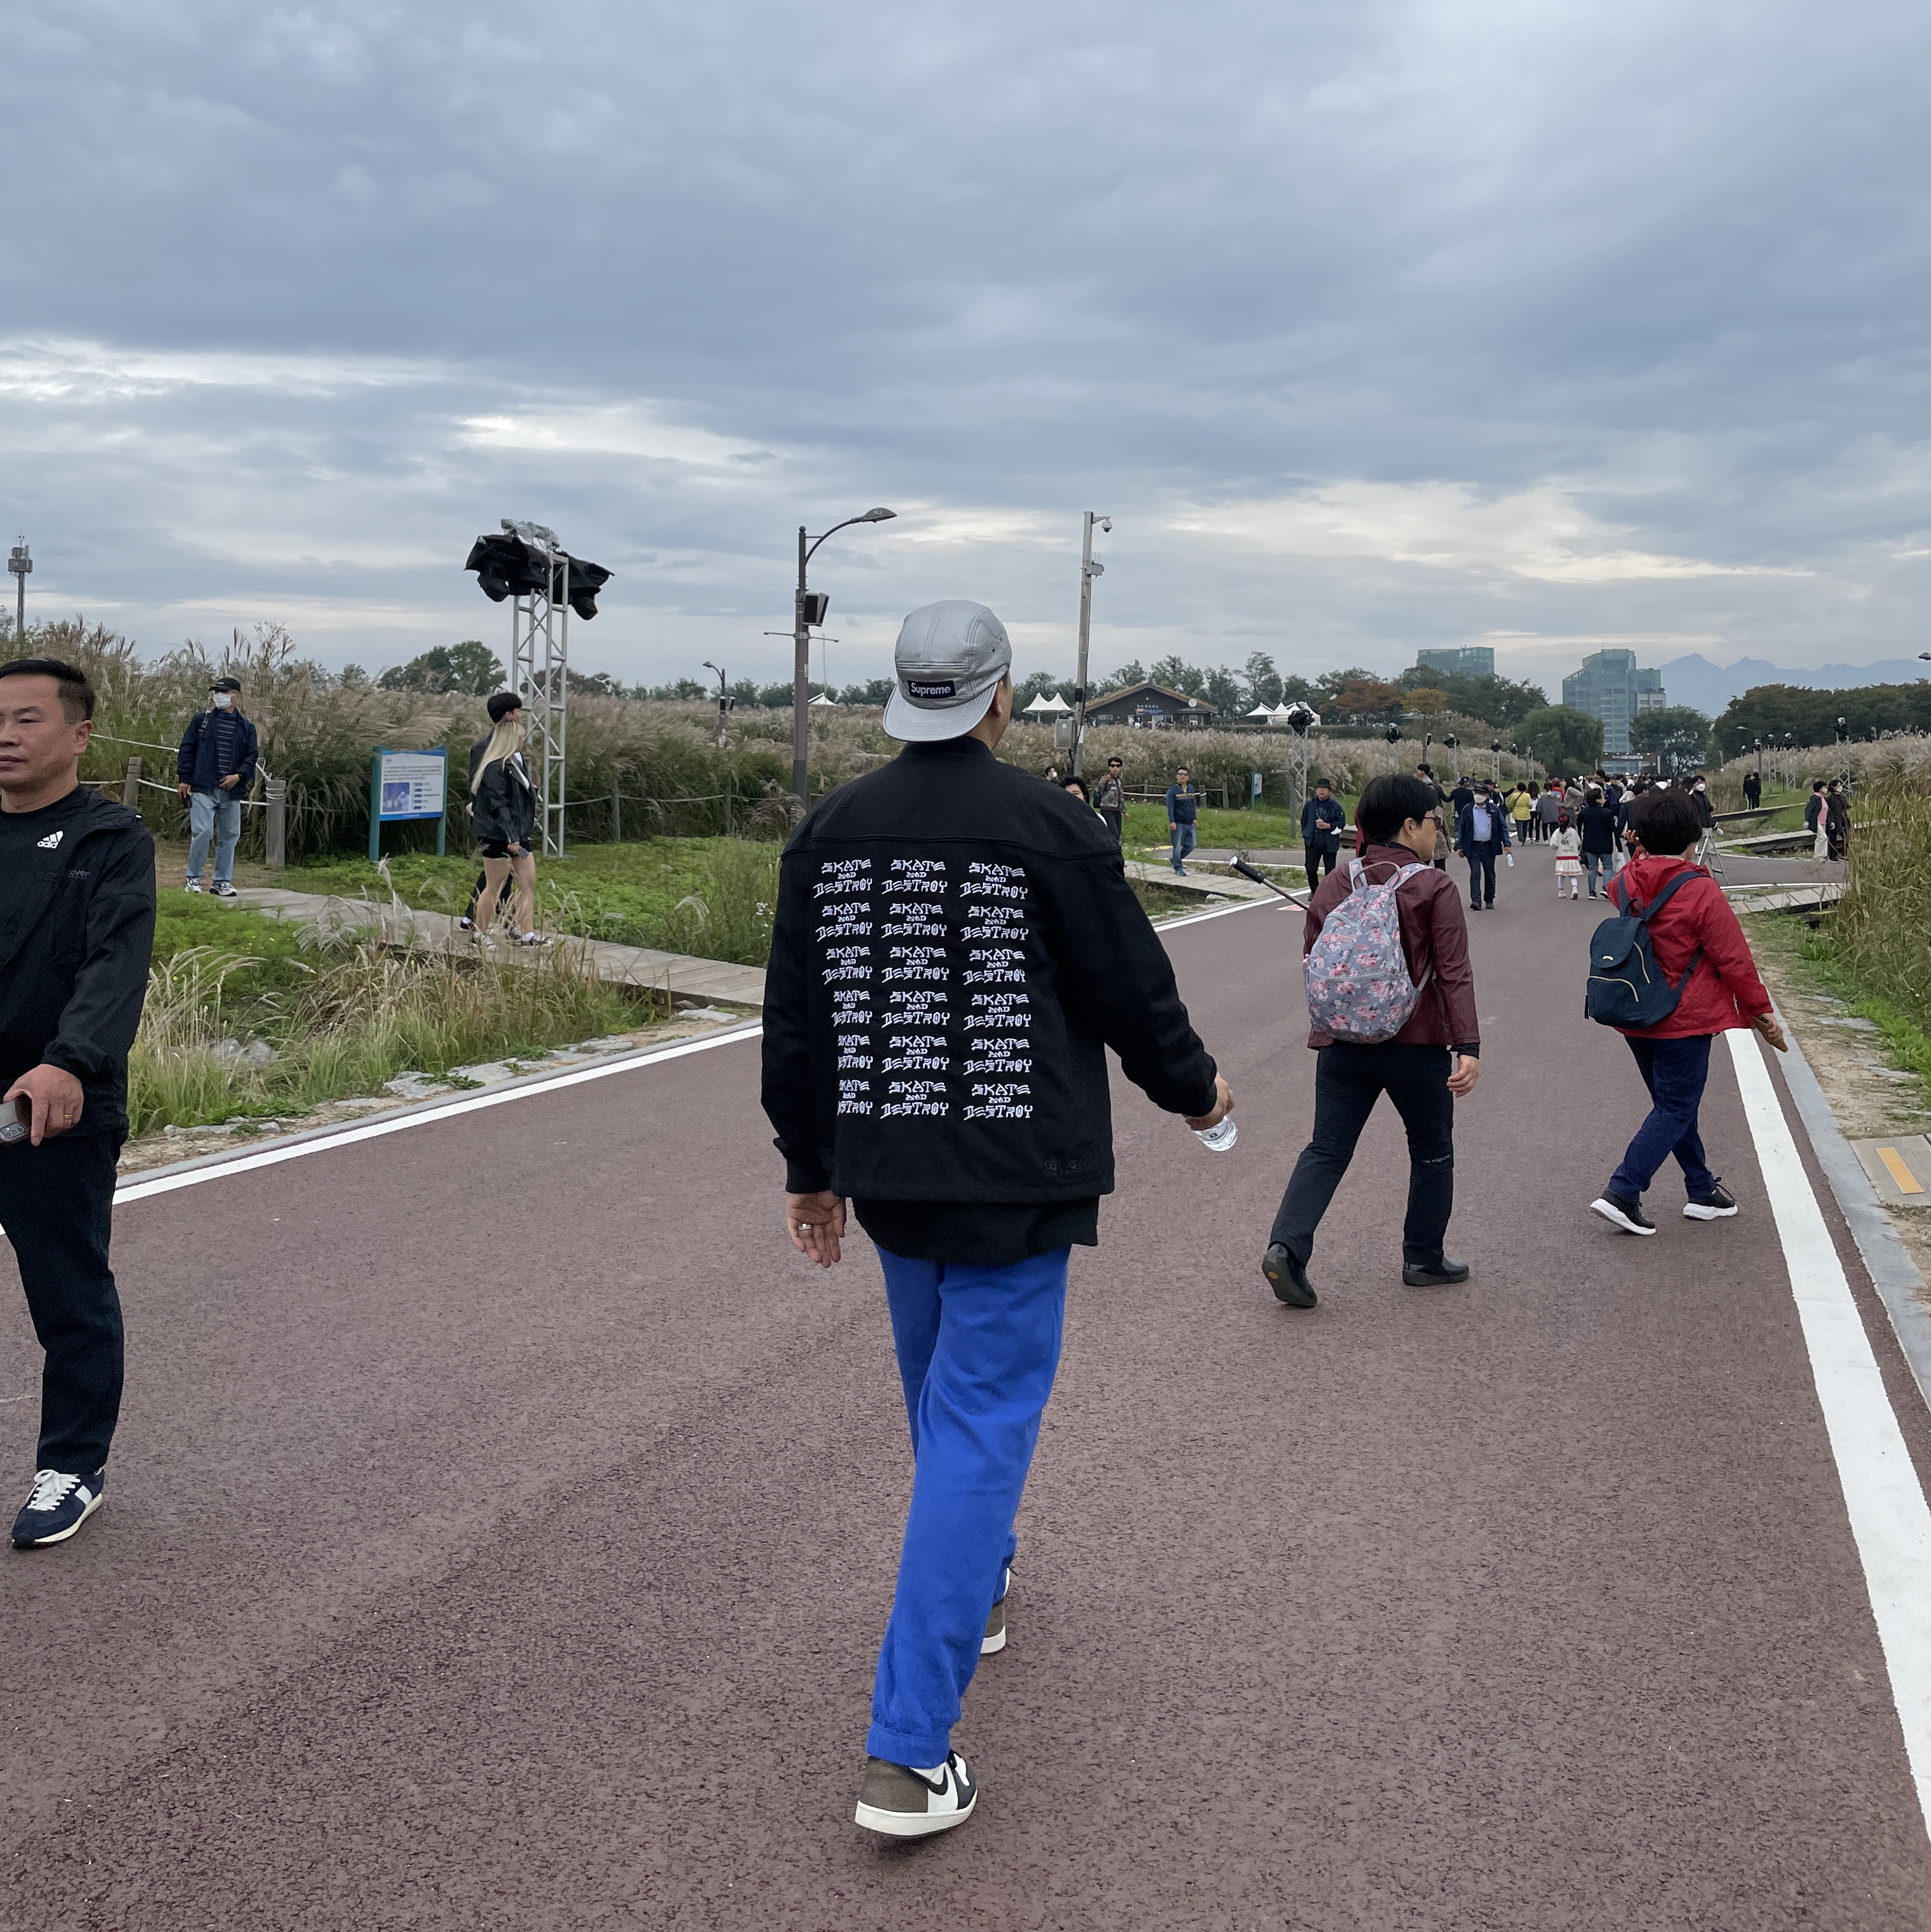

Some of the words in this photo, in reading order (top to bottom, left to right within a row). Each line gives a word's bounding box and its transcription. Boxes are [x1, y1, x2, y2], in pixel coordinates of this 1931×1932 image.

[911, 682, 950, 697] Supreme
[821, 859, 872, 874] SKATE
[890, 859, 946, 871] SKATE
[968, 861, 1026, 877] SKATE
[837, 871, 857, 880] AND
[985, 875, 1007, 883] AND
[813, 877, 873, 899] DESTROY
[881, 878, 948, 895] DESTROY
[959, 882, 1028, 900] DESTROY
[821, 902, 871, 917] SKATE
[889, 902, 943, 915] SKATE
[968, 905, 1024, 919] SKATE
[814, 921, 873, 942] DESTROY
[880, 923, 947, 939] DESTROY
[959, 925, 1029, 942] DESTROY
[825, 946, 871, 960] SKATE
[889, 946, 947, 958] SKATE
[969, 948, 1026, 962] SKATE
[821, 965, 873, 985] DESTROY
[881, 966, 950, 983] DESTROY
[833, 989, 871, 1003] SKATE
[889, 990, 948, 1004] SKATE
[971, 993, 1030, 1006] SKATE
[881, 1011, 950, 1029] DESTROY
[963, 1013, 1032, 1031] DESTROY
[889, 1035, 948, 1048] SKATE
[971, 1038, 1030, 1051] SKATE
[880, 1055, 950, 1073] DESTROY
[963, 1059, 1032, 1076] DESTROY
[888, 1080, 947, 1094] SKATE
[971, 1083, 1031, 1097] SKATE
[880, 1101, 949, 1119] DESTROY
[963, 1104, 1034, 1121] DESTROY
